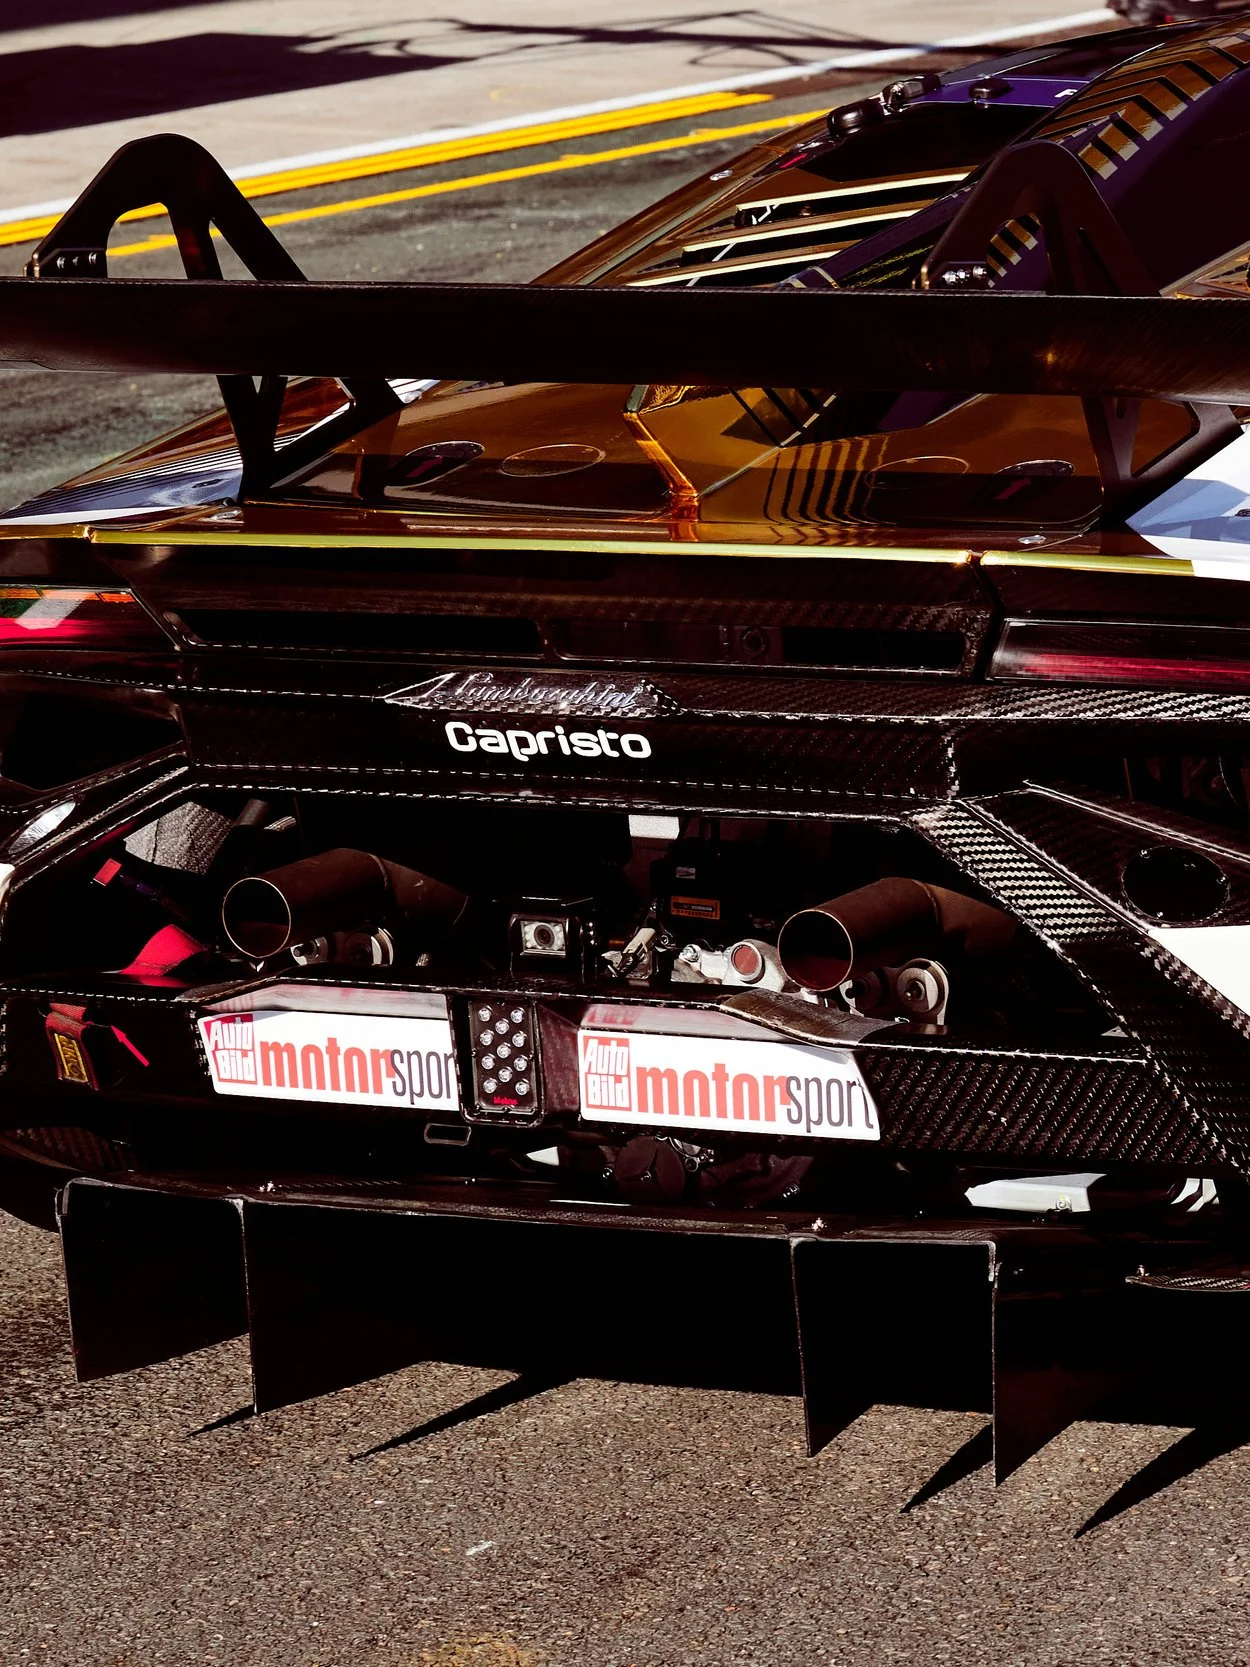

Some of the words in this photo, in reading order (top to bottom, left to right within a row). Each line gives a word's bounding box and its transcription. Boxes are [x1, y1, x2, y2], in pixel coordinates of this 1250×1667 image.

[445, 721, 652, 762] Capristo
[210, 1017, 253, 1051] Auto
[215, 1050, 256, 1082] Bild
[259, 1036, 455, 1105] motorspor
[584, 1038, 628, 1075] Auto
[587, 1075, 630, 1108] Bild
